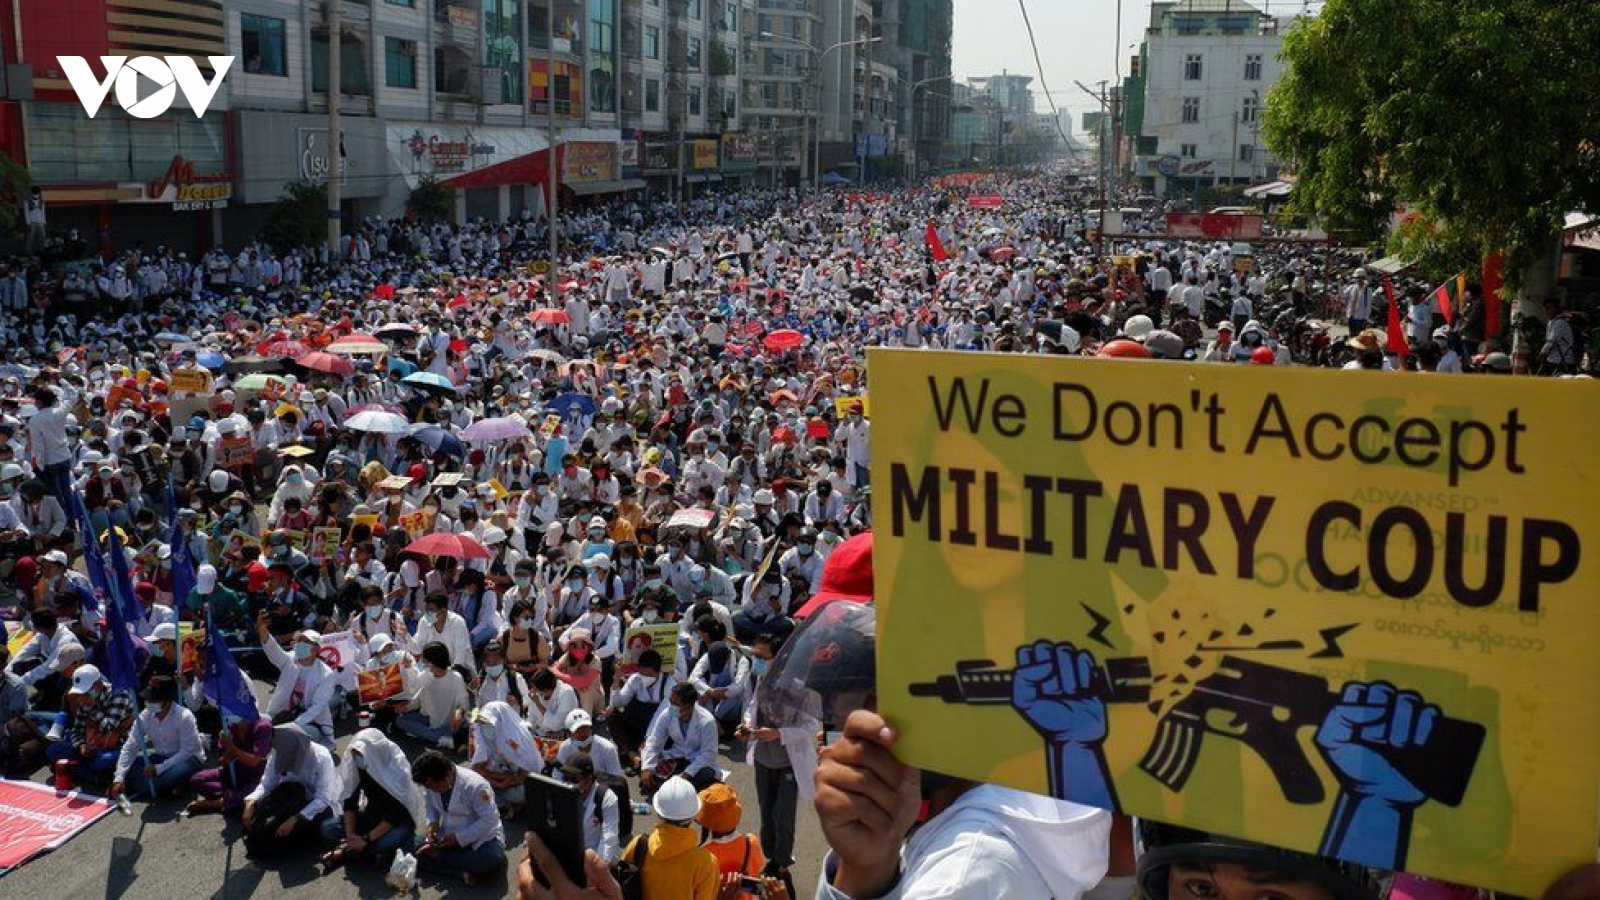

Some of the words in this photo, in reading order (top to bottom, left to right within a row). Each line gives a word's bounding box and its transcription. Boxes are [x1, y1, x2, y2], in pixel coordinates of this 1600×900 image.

[928, 375, 1027, 439] We
[1052, 381, 1226, 453] Don't
[1244, 393, 1527, 488] Accept
[890, 462, 1276, 580] MILITARY
[1305, 500, 1582, 614] COUP
